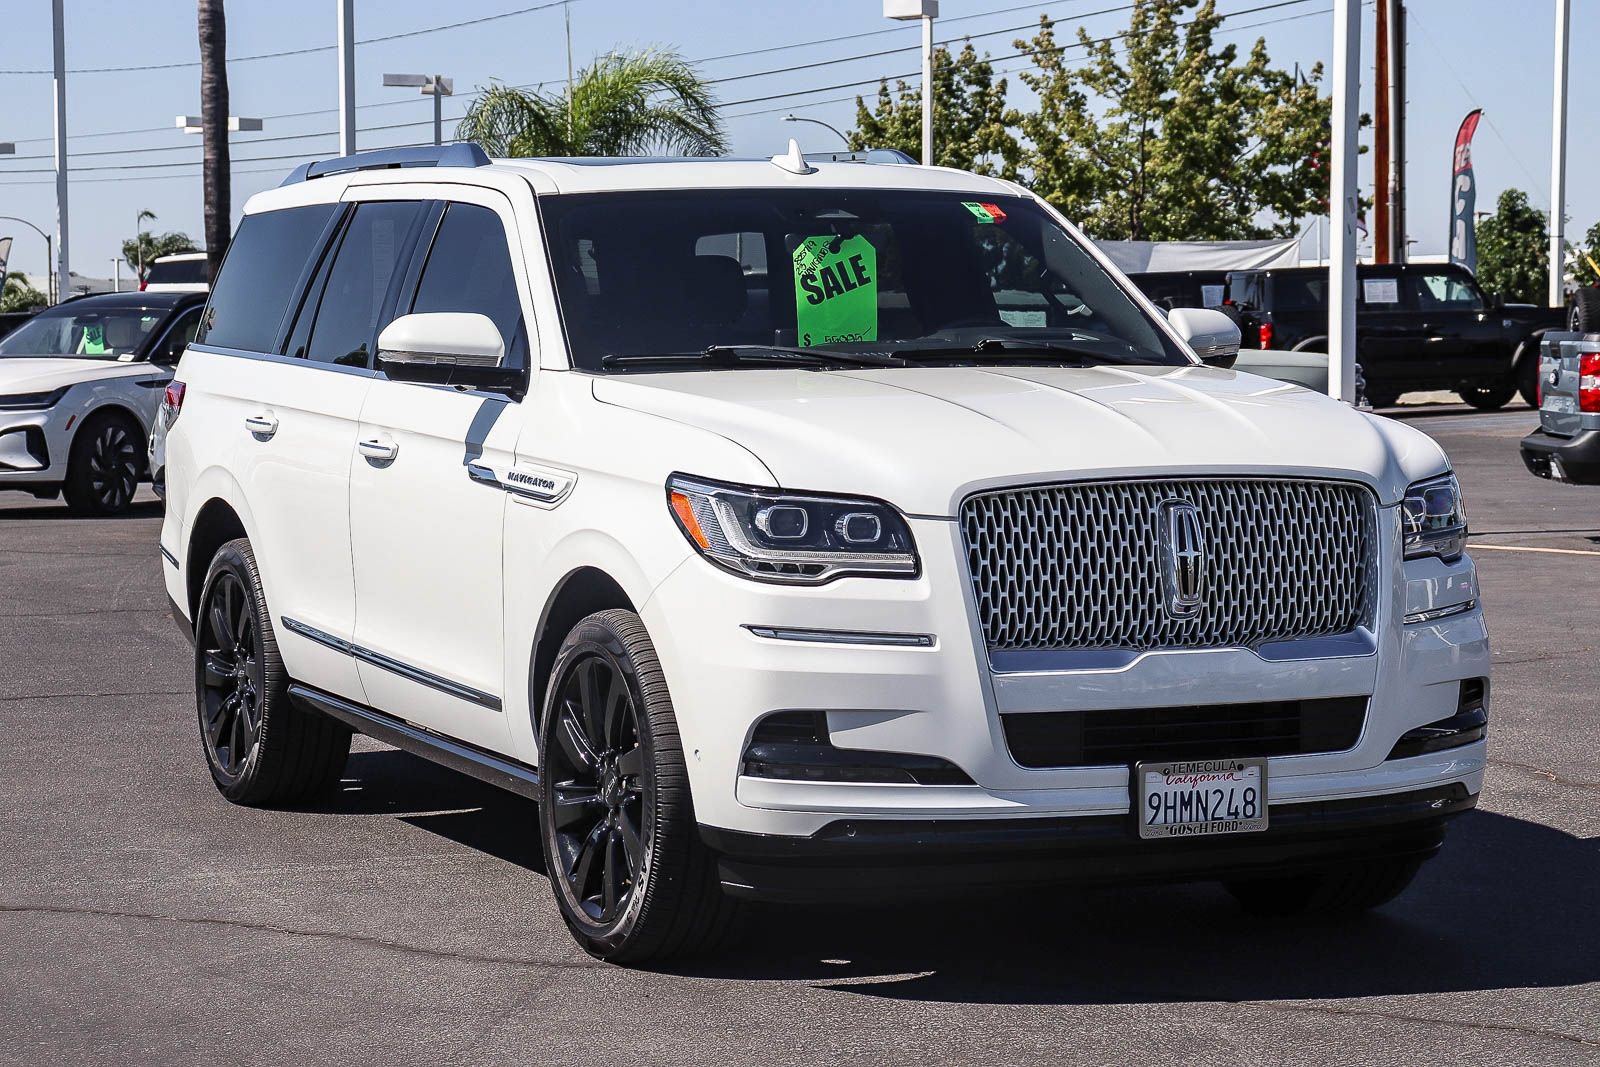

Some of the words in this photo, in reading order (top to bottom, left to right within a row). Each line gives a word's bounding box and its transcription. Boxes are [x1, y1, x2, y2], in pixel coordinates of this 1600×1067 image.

[800, 253, 872, 305] SALE
[803, 332, 811, 346] $
[508, 472, 554, 490] NAVIGATOR
[1171, 760, 1235, 774] TEMECULA
[1165, 772, 1242, 789] California
[1148, 787, 1257, 825] 9HMN248
[1211, 820, 1238, 833] FORD
